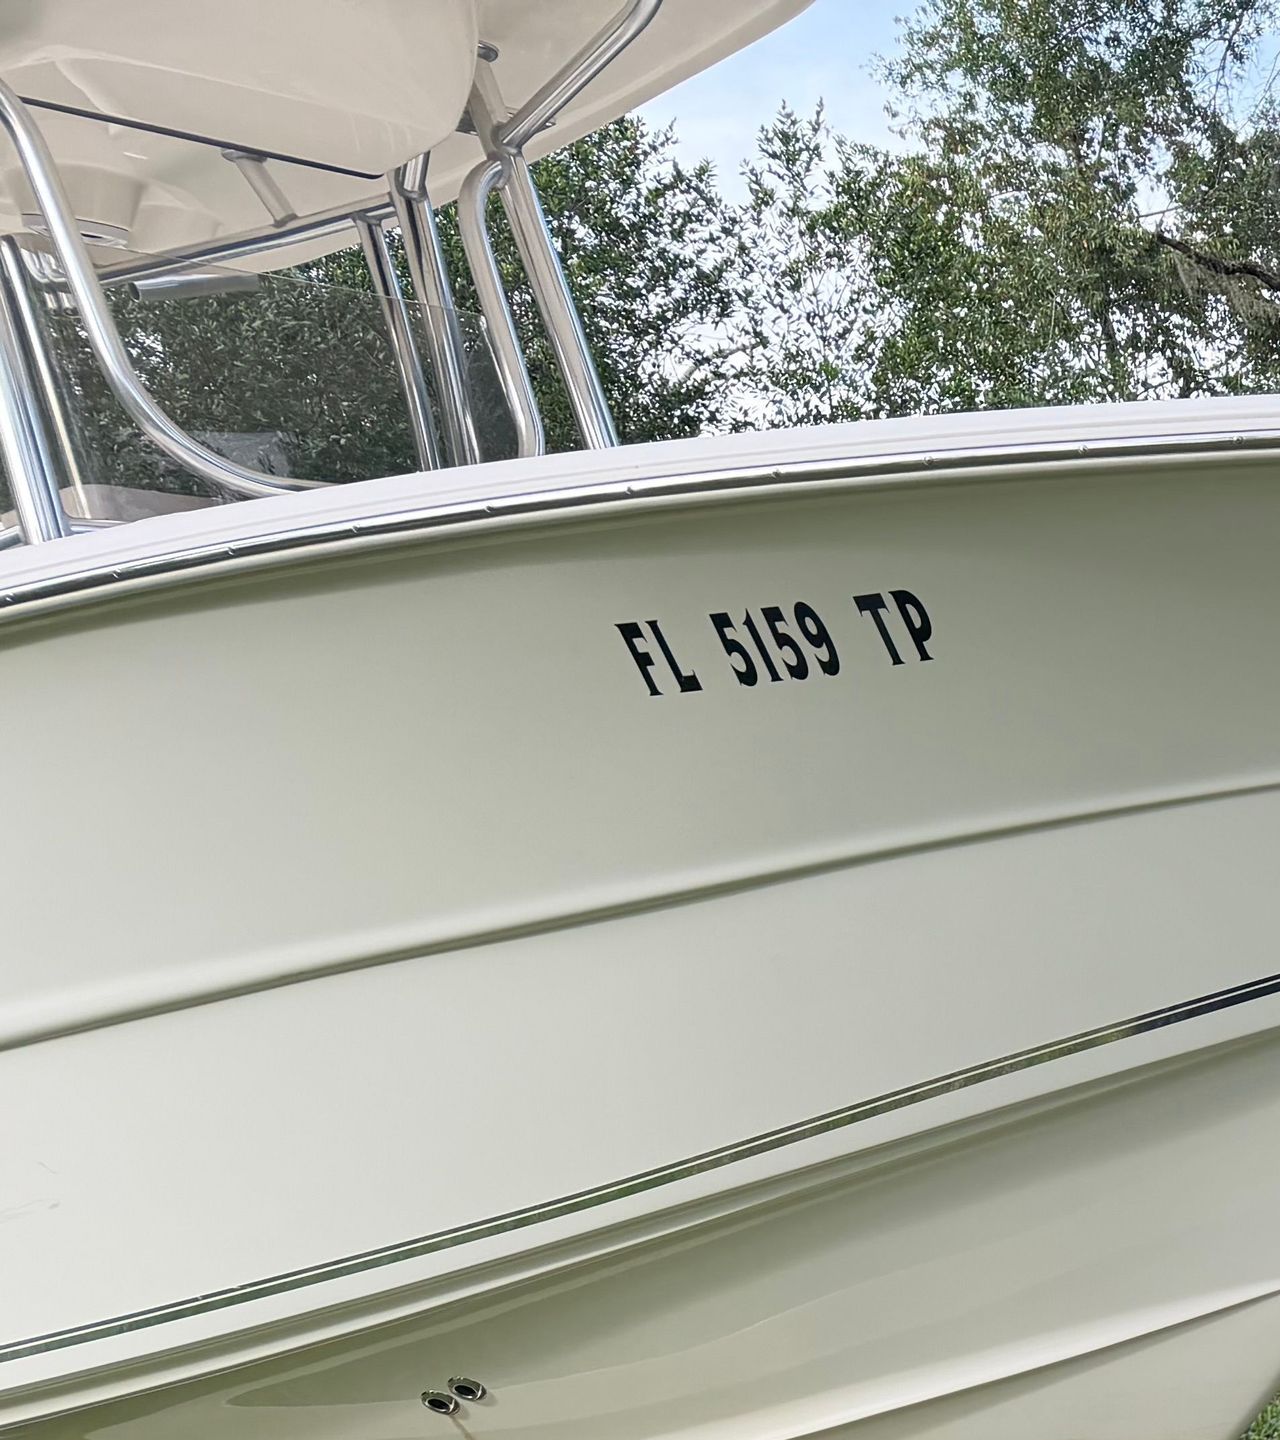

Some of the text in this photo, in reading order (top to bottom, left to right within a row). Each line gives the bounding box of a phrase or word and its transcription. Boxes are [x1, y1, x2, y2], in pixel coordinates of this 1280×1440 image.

[614, 589, 934, 696] FL 5159 TP
